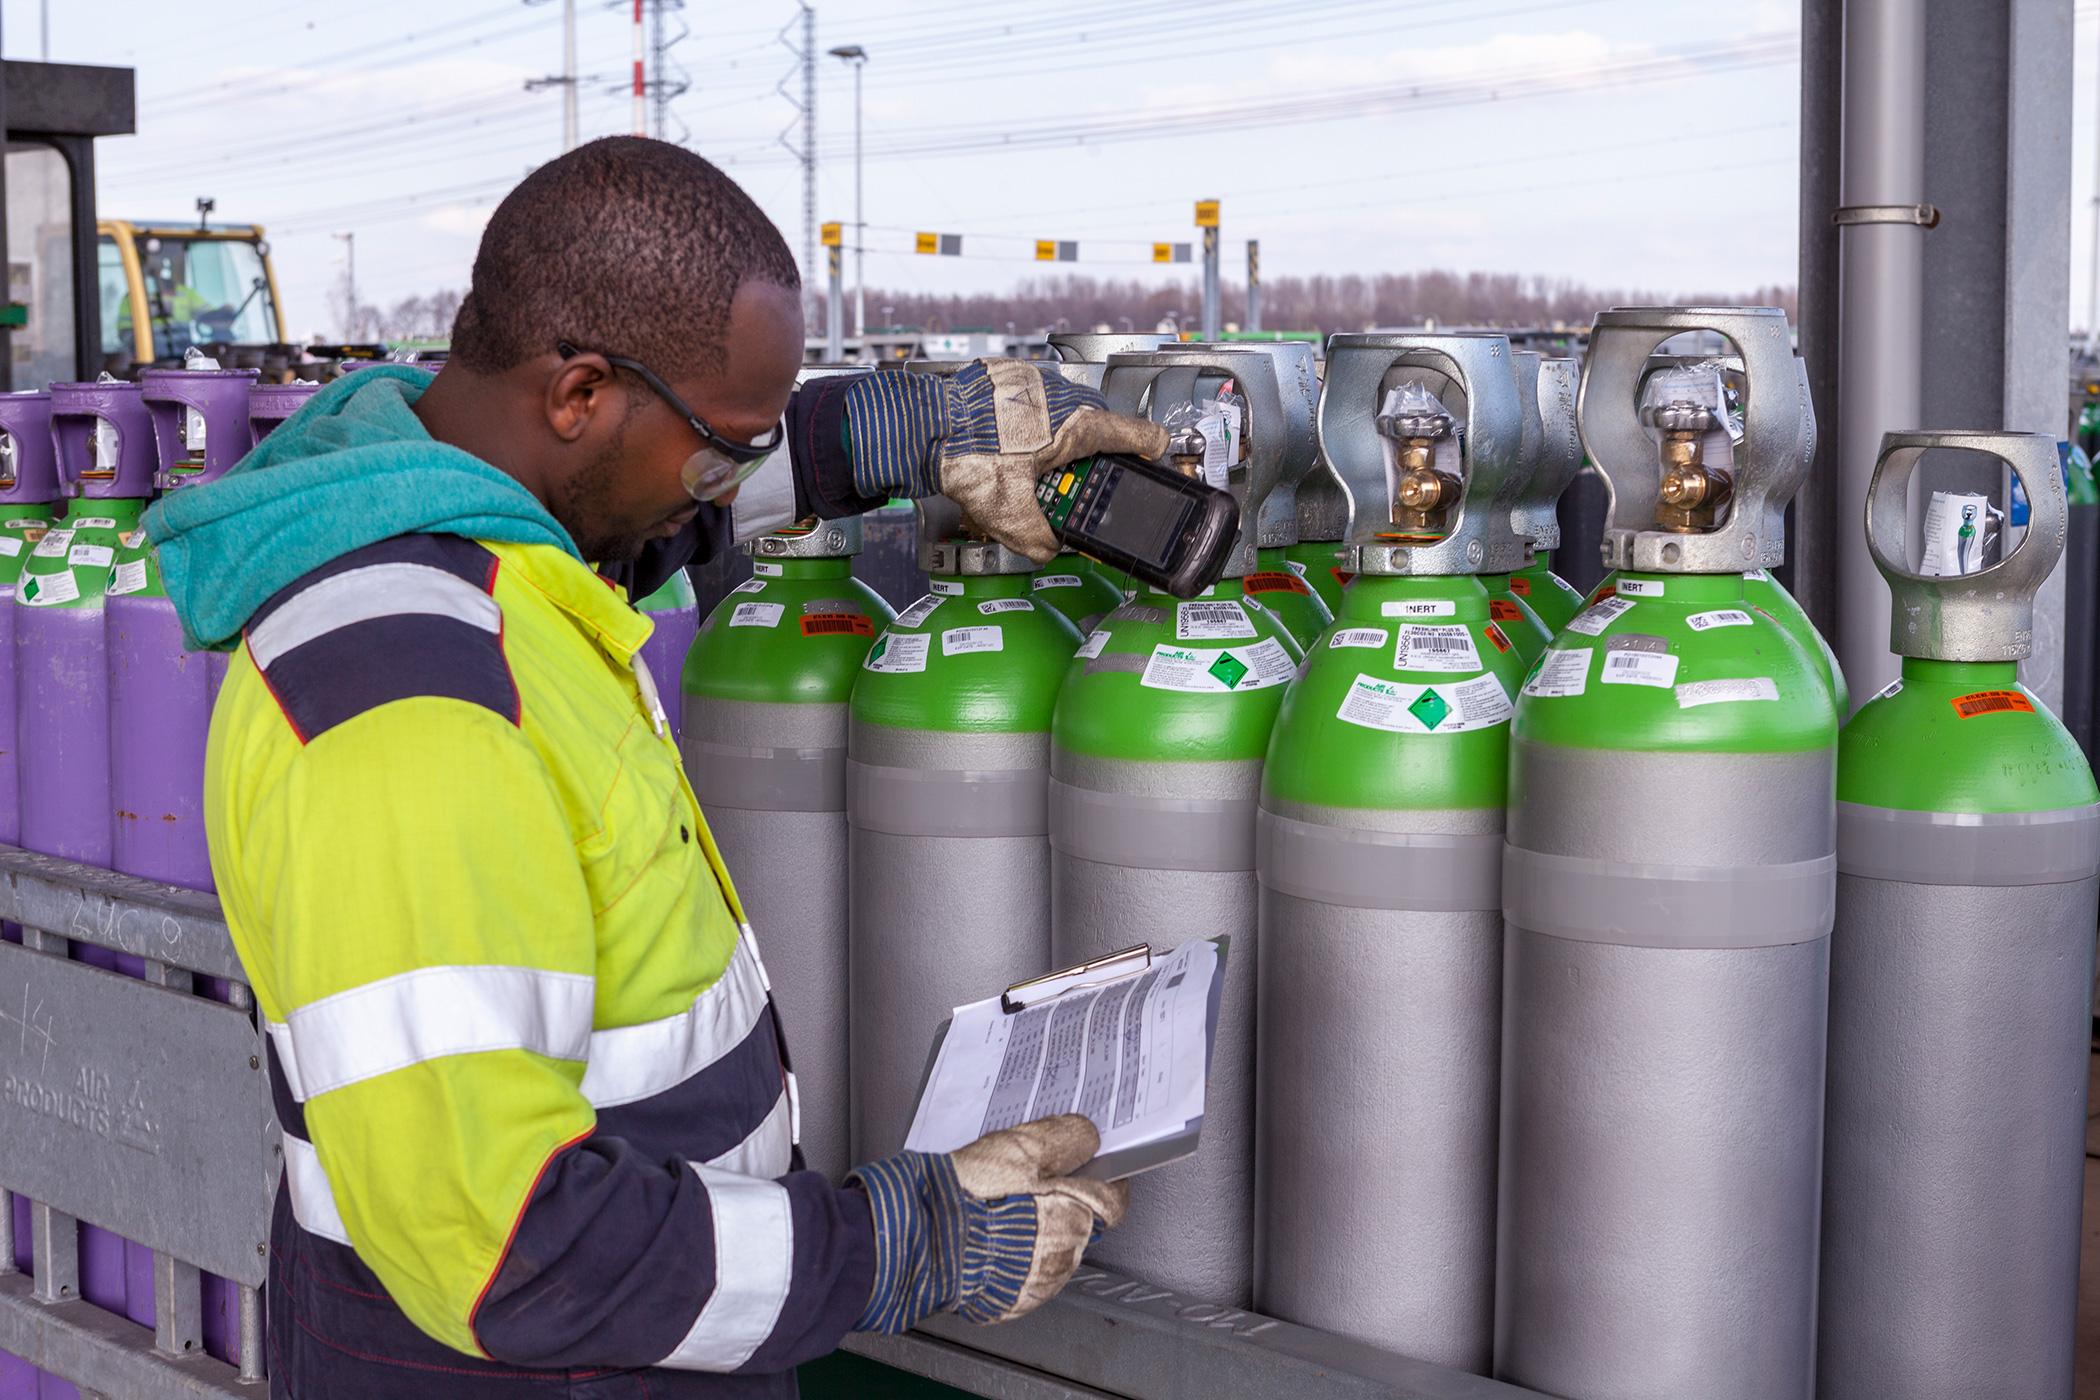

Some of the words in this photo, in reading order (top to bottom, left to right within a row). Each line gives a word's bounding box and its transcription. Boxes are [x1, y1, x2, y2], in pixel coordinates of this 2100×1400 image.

[1180, 610, 1190, 638] UN1956
[1405, 604, 1437, 614] INERT
[1397, 634, 1411, 667] UN1956
[73, 1066, 111, 1103] AIR
[3, 1074, 111, 1138] PRODUCTS
